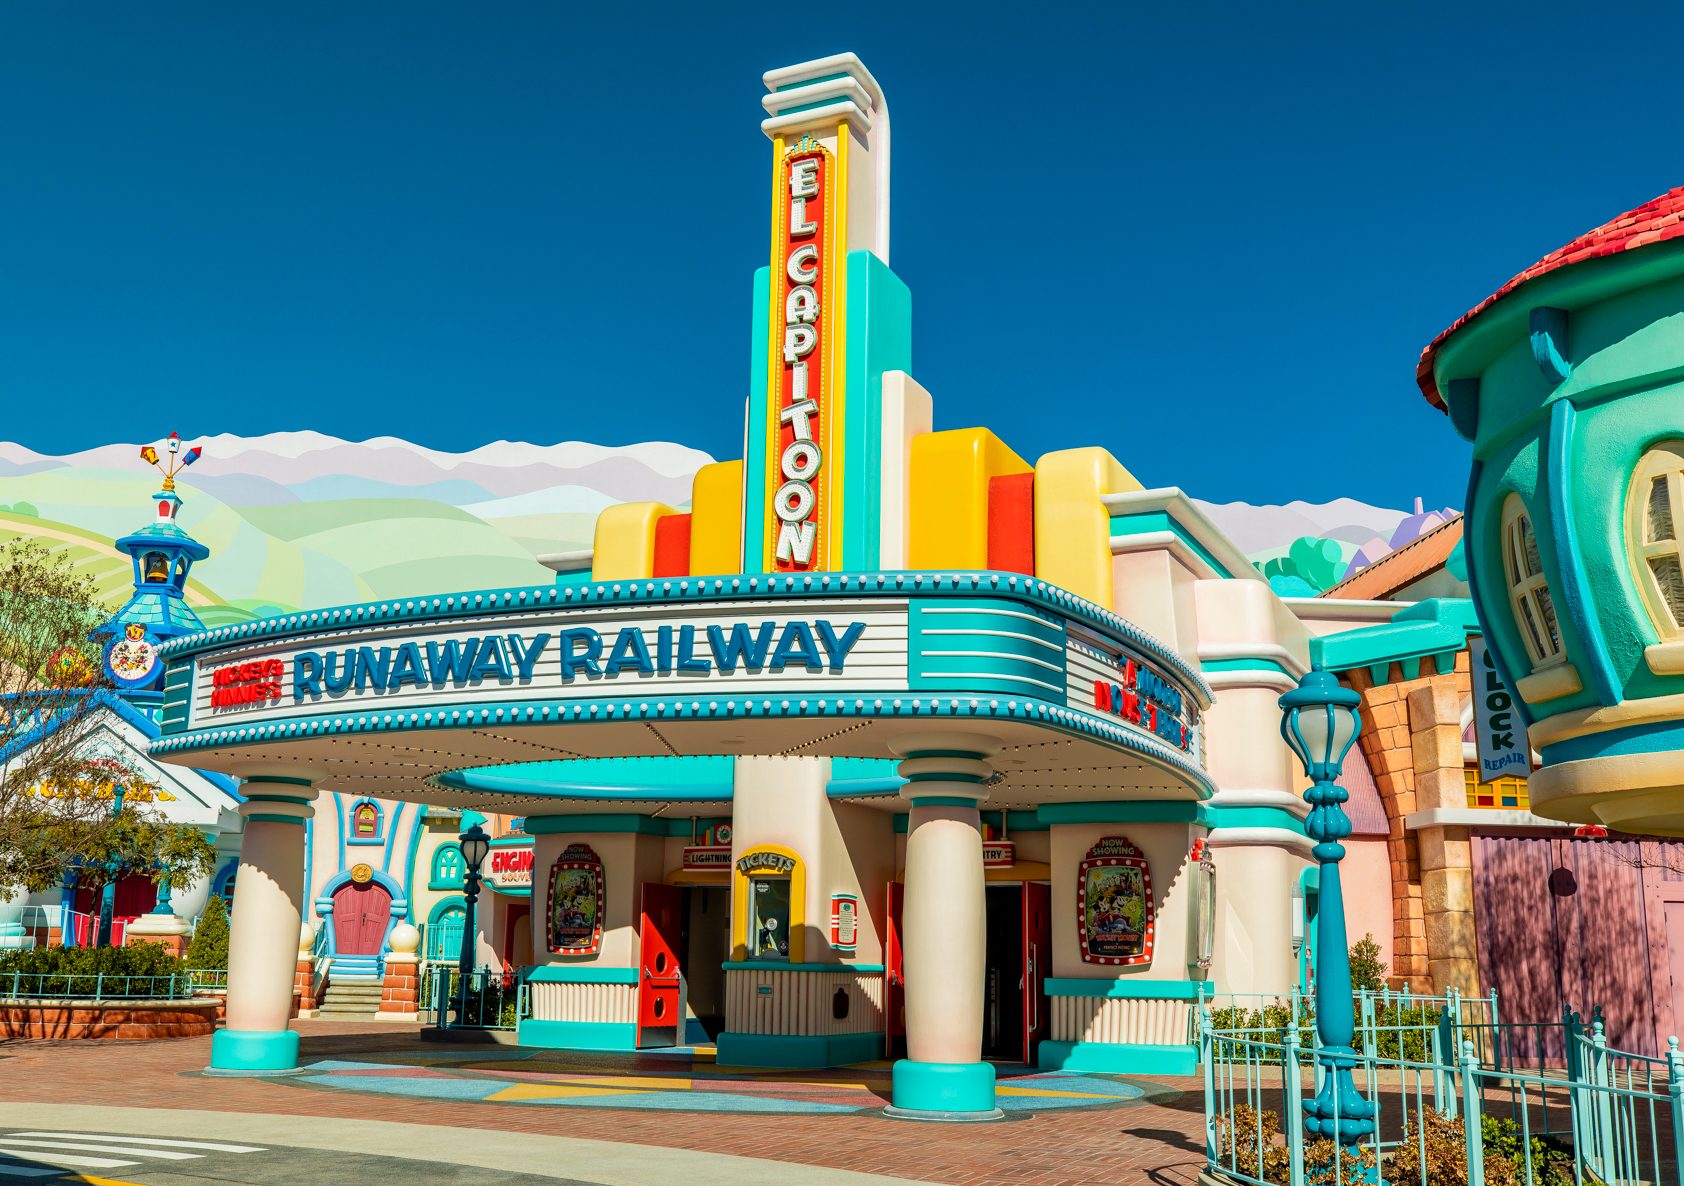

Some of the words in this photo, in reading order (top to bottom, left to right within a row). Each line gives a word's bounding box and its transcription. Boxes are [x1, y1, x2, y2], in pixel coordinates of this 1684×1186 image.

[774, 243, 822, 565] CAPITOON
[293, 633, 550, 700] RUNAWAY
[560, 619, 866, 680] RAILWAY
[1483, 752, 1526, 771] REPAIR
[1092, 847, 1135, 856] SHOWING
[1102, 839, 1123, 847] NOW
[737, 852, 796, 872] TICKETS
